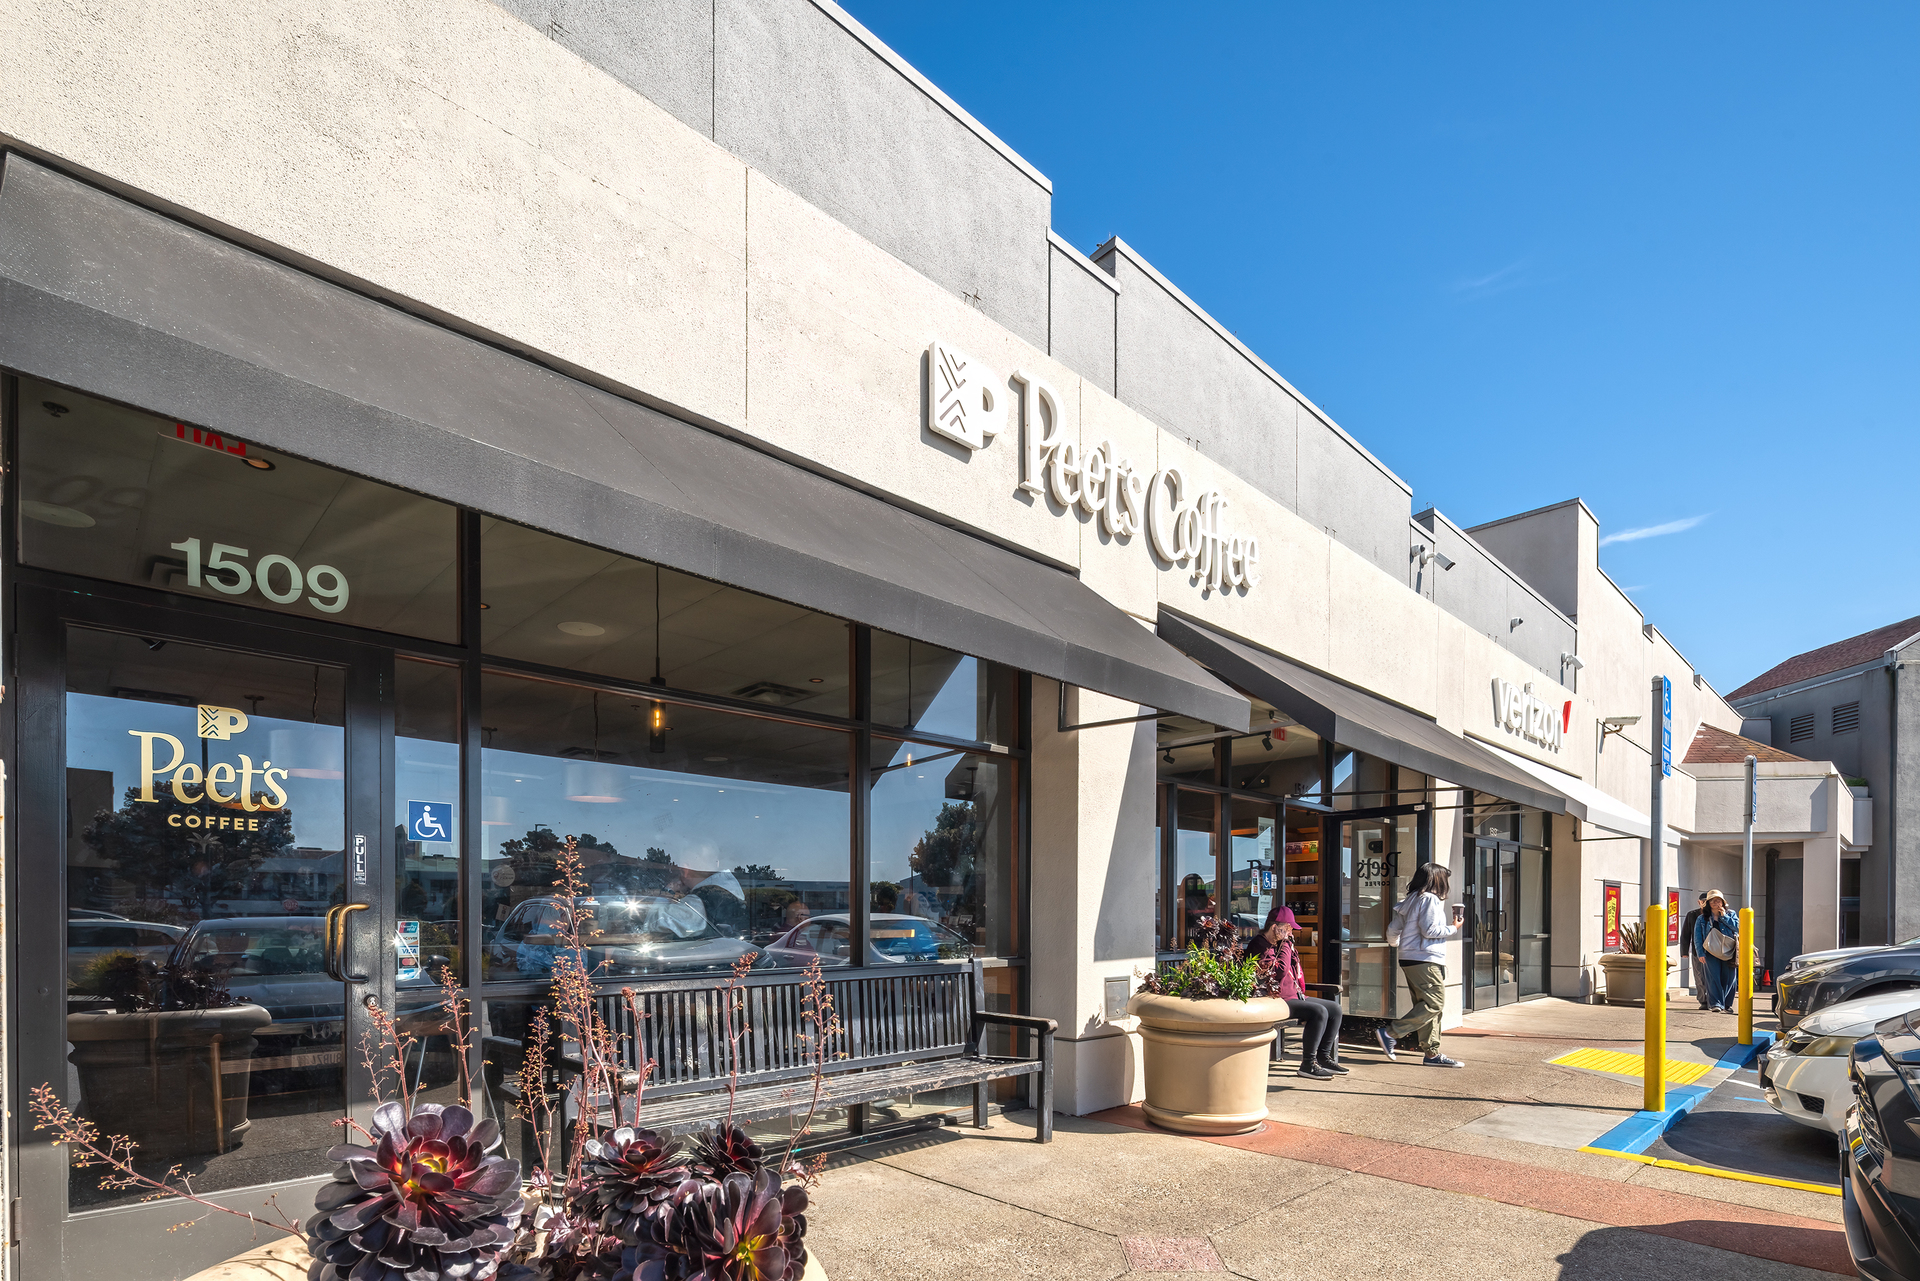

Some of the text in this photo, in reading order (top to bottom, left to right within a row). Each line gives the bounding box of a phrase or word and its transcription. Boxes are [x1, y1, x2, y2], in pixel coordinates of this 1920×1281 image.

[1150, 467, 1261, 591] Coffee
[171, 537, 350, 614] 1509
[1491, 677, 1564, 749] verizon
[128, 730, 288, 812] Peet's
[167, 814, 259, 831] COFFEE
[355, 838, 364, 872] PULL
